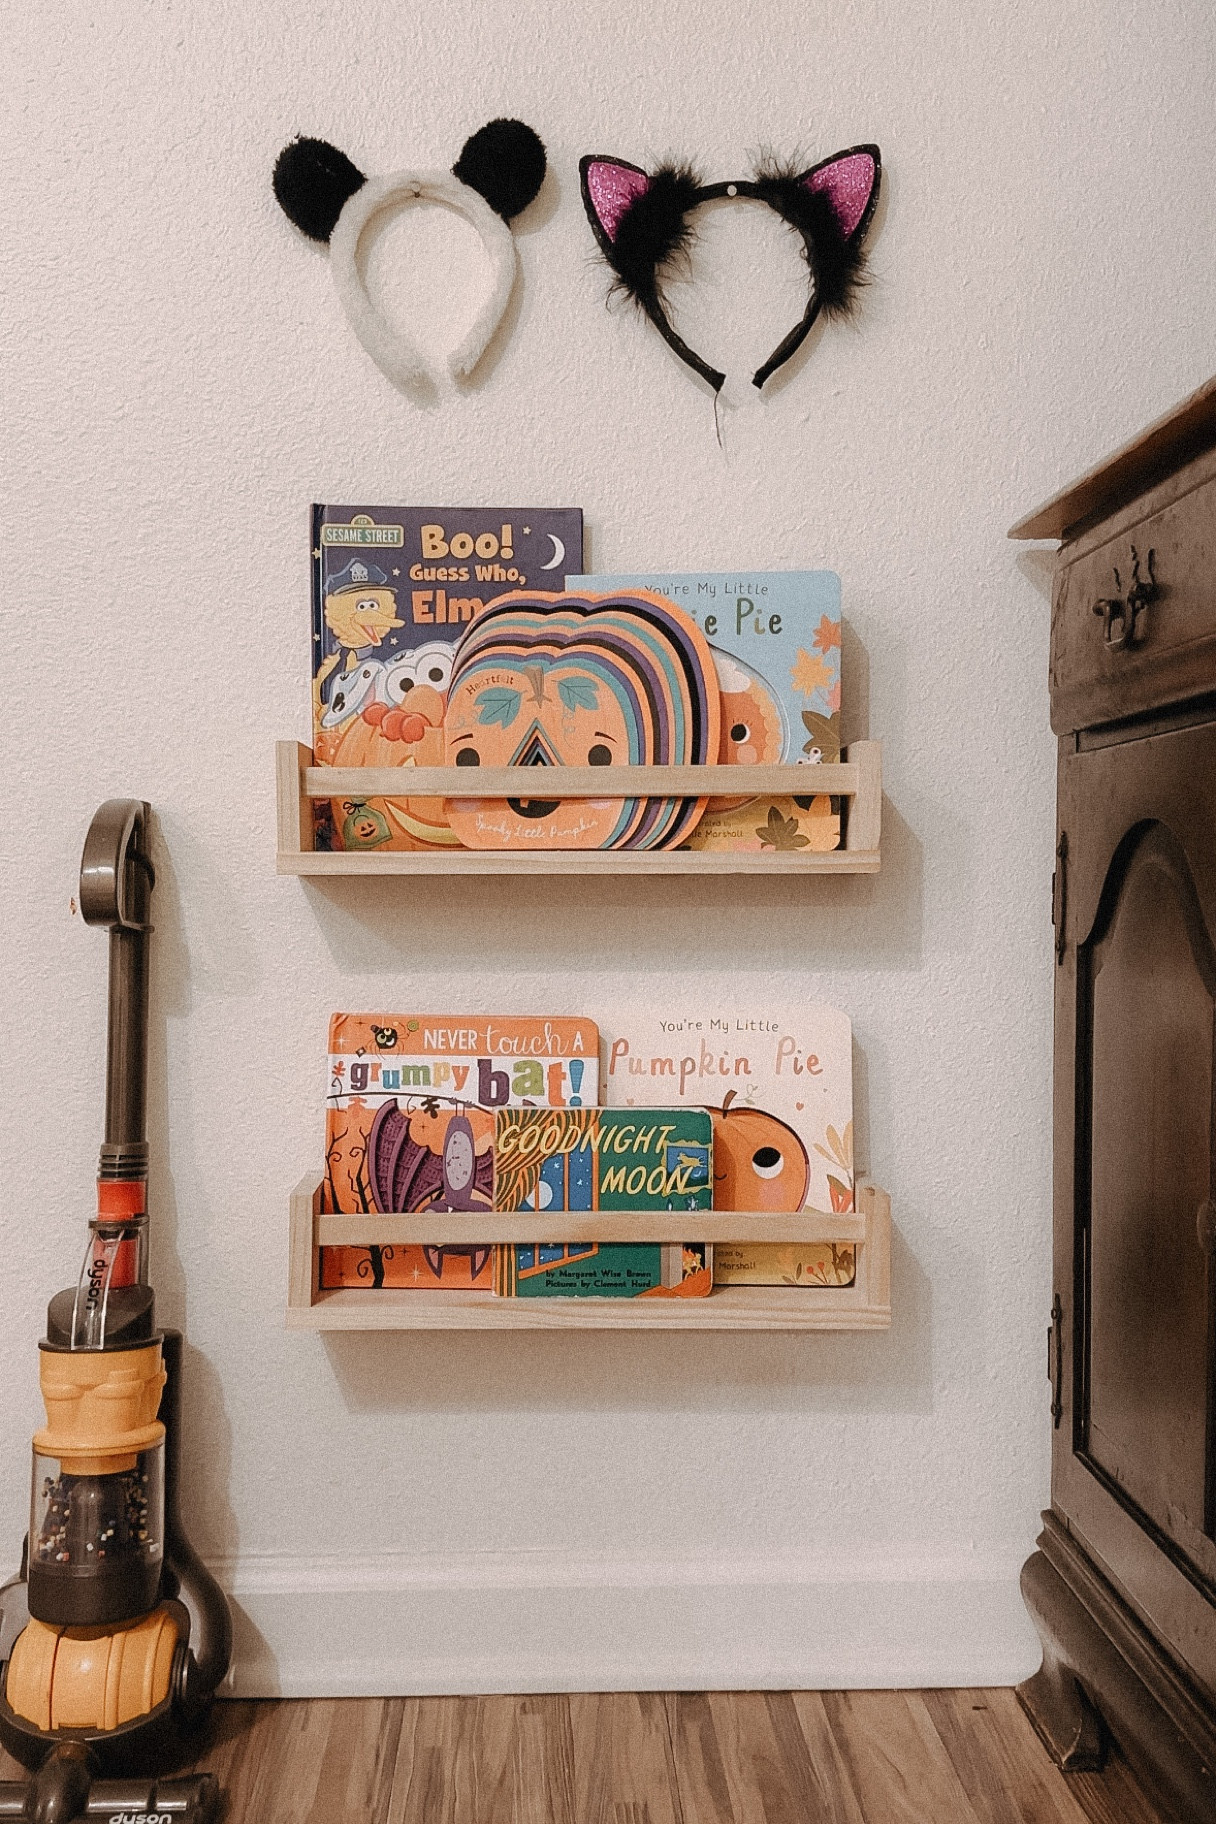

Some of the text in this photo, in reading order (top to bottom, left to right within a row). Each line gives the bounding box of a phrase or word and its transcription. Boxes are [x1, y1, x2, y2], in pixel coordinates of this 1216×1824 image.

[326, 529, 398, 543] SESAME STREET
[420, 524, 514, 559] Boo!
[409, 562, 526, 585] Guess Who,
[697, 582, 716, 598] My
[724, 582, 769, 596] Little
[736, 597, 783, 636] Pie
[423, 1022, 584, 1056] NEVER touch A
[659, 1018, 779, 1034] You're My Little
[608, 1035, 824, 1095] Pumpkin Pie
[350, 1058, 585, 1107] grumpy bat!
[499, 1124, 677, 1154] GOODNIGHT
[600, 1165, 694, 1194] MOON
[85, 1258, 108, 1311] dyson
[545, 1269, 652, 1279] by Margaret Wise Brown
[545, 1279, 651, 1289] Pictures by Clement Hurd
[109, 1812, 172, 1824] dyson
